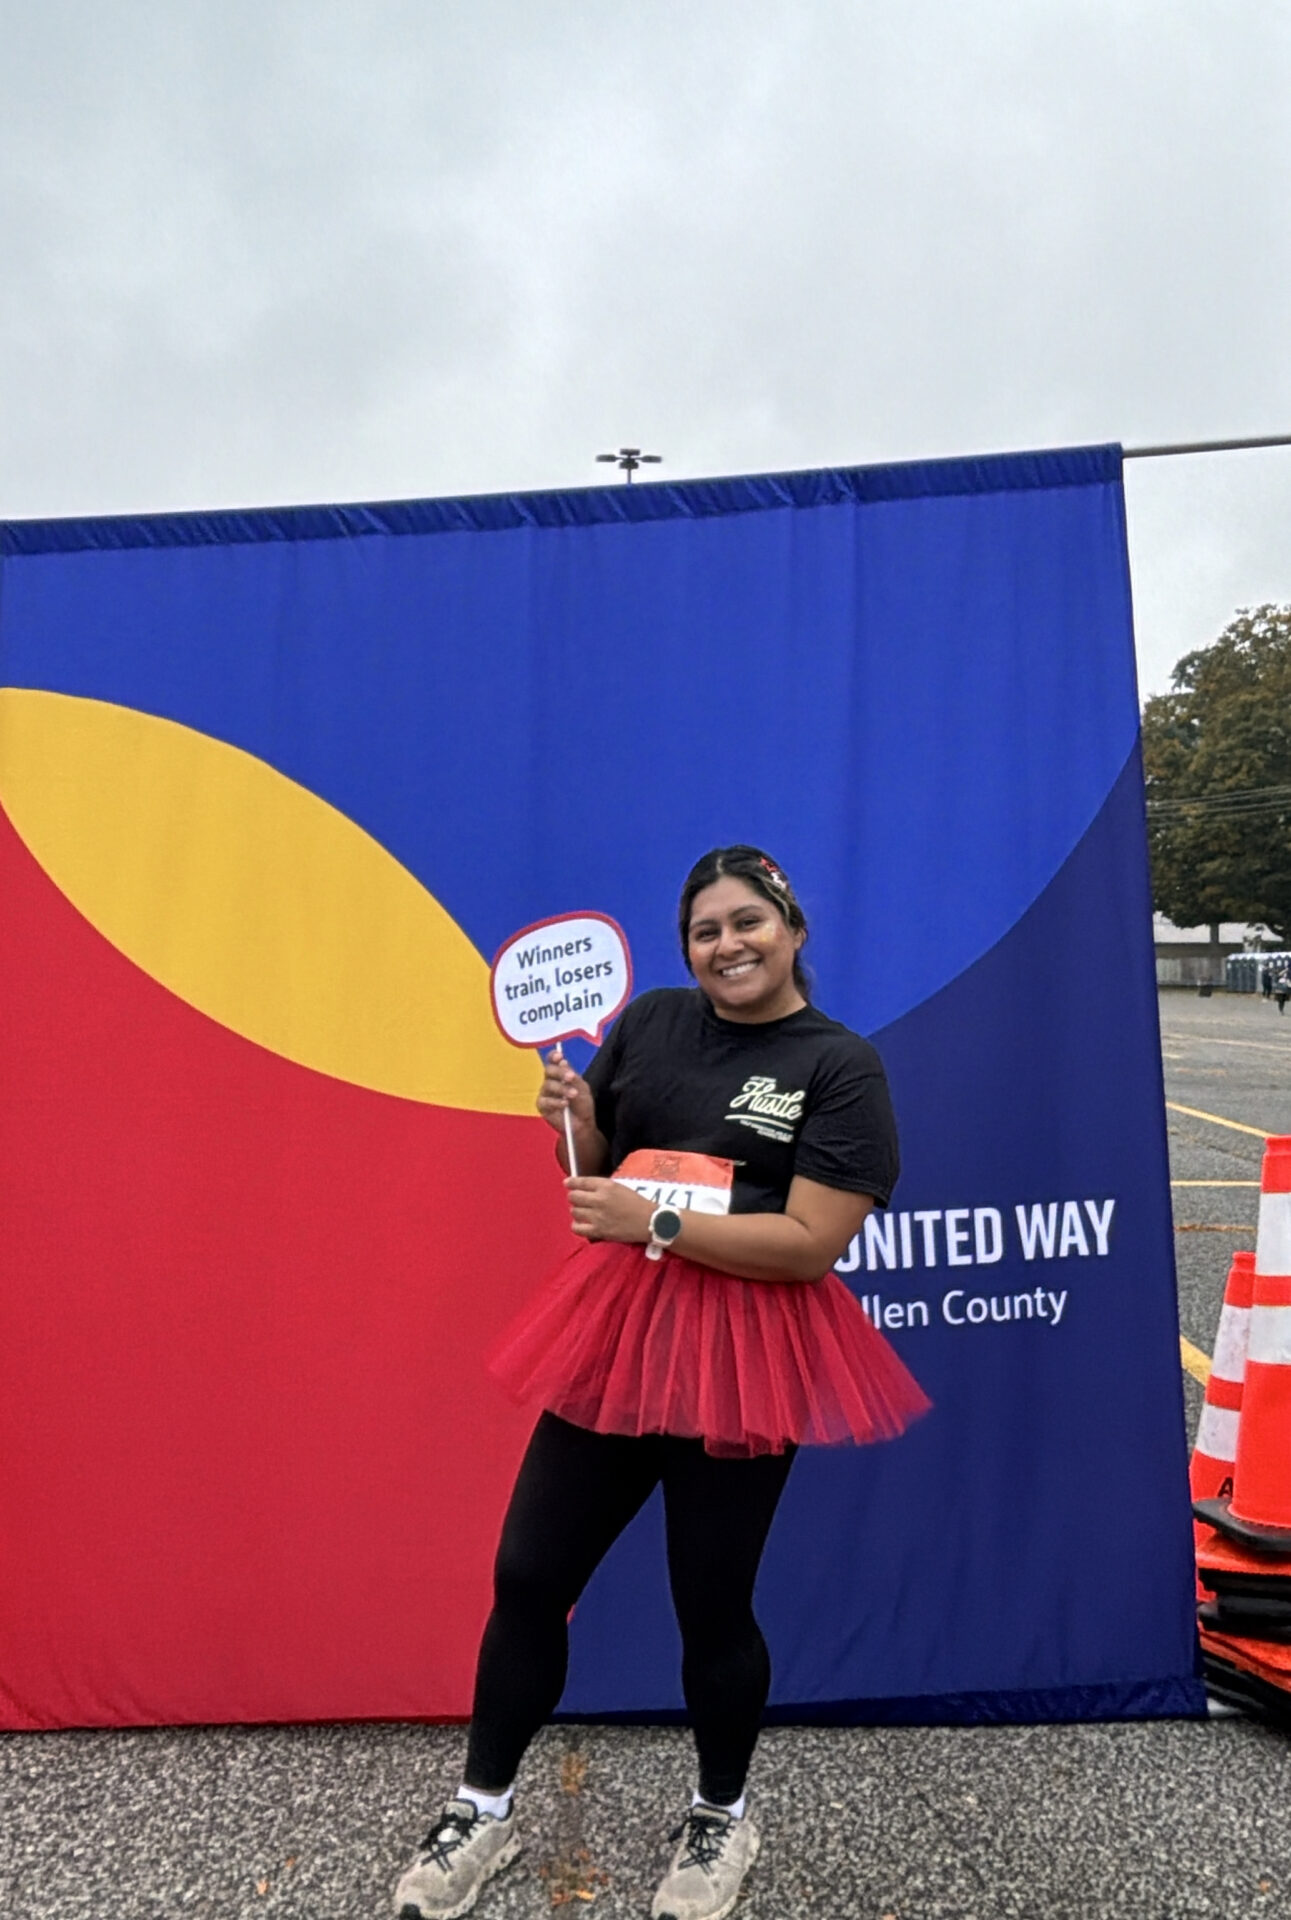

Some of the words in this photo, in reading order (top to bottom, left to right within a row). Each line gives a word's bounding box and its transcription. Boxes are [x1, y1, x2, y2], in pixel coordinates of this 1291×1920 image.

[516, 936, 592, 970] Winners
[504, 974, 551, 1001] train,
[554, 960, 613, 988] losers
[518, 988, 603, 1025] complain
[729, 1080, 805, 1120] Hustle
[1015, 1199, 1116, 1261] WAY
[861, 1294, 930, 1330] llen
[942, 1286, 1068, 1326] County
